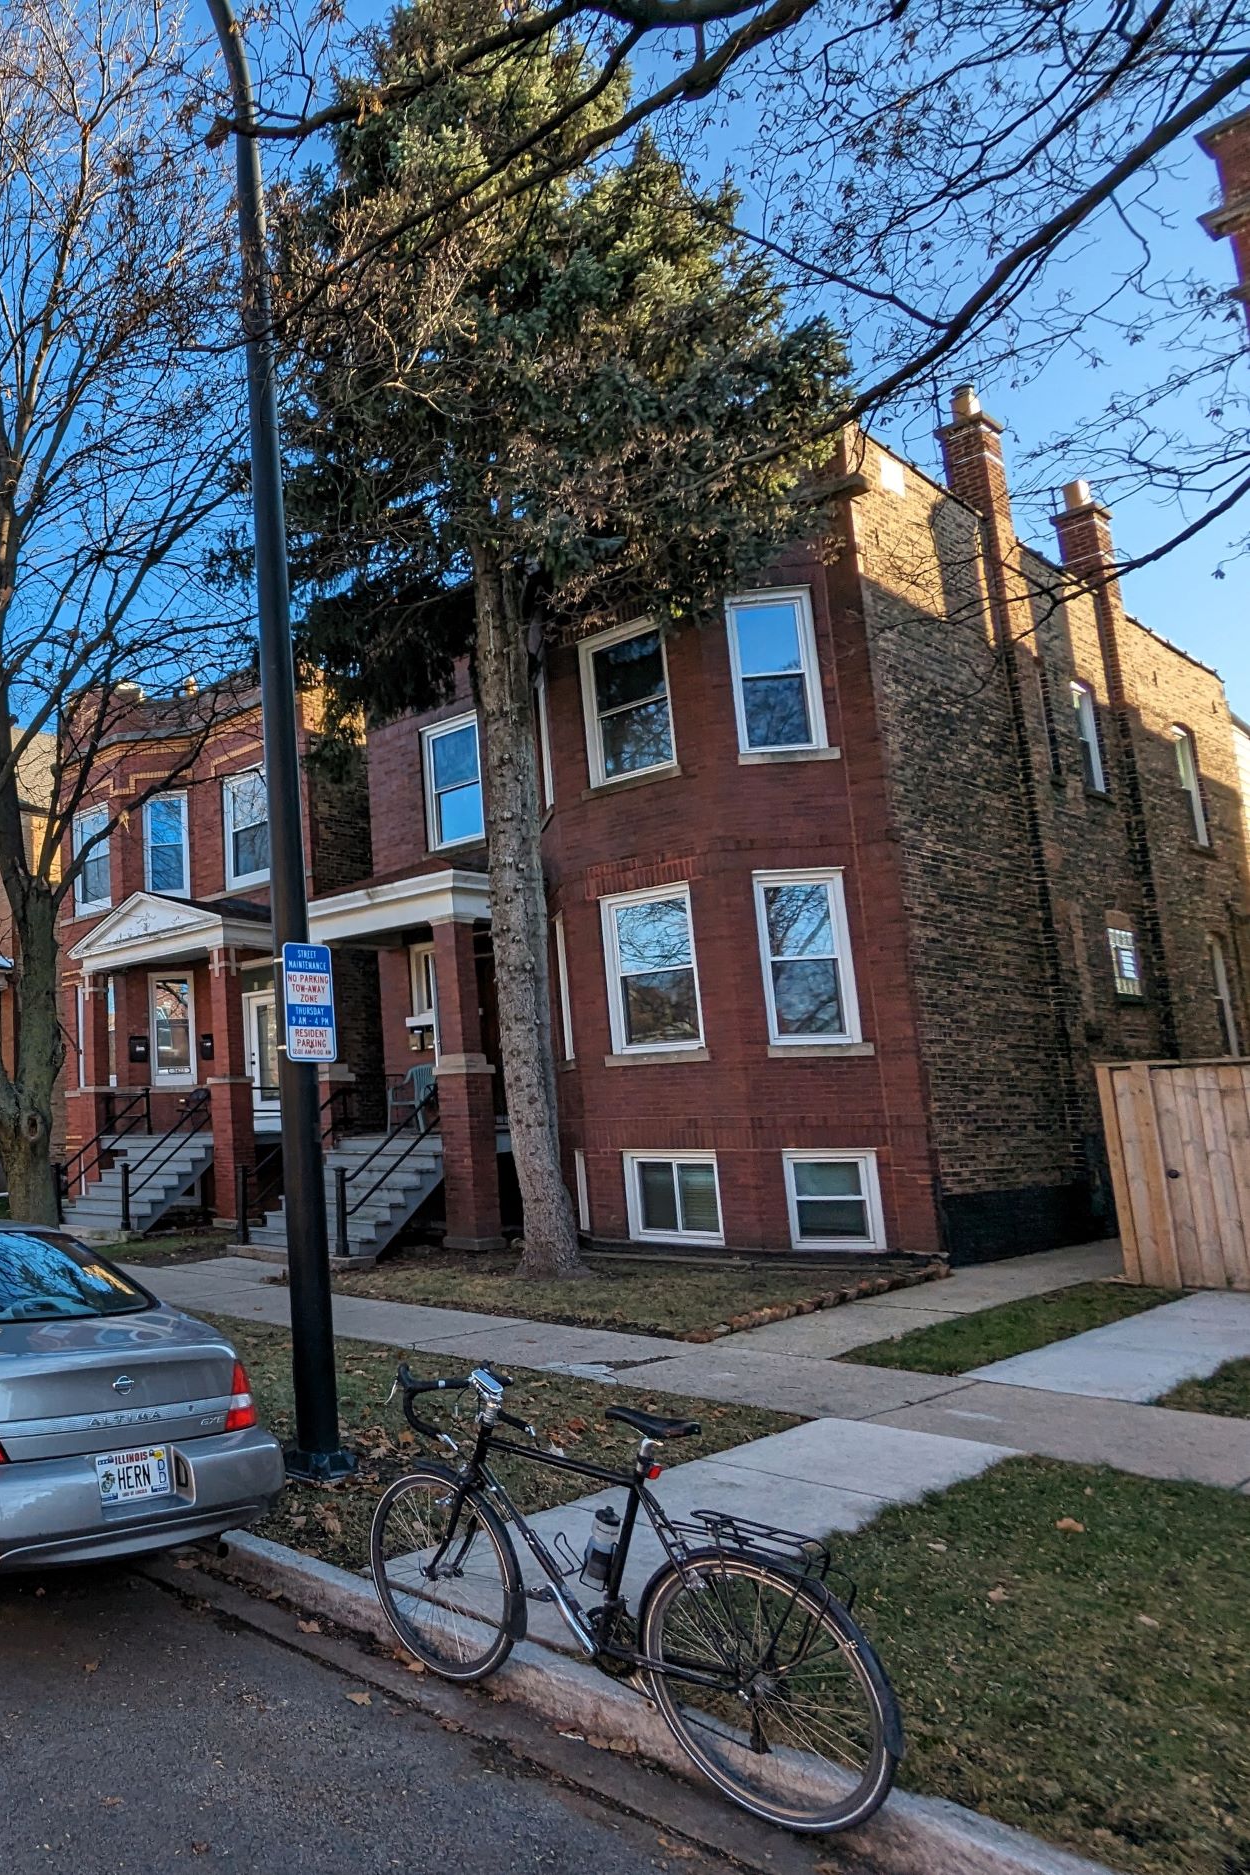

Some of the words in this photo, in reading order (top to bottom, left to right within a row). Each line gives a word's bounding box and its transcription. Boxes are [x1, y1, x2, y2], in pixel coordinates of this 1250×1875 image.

[297, 949, 317, 960] STREET
[288, 960, 327, 971] MAINTENANCE
[287, 974, 298, 983] NO
[299, 974, 329, 984] PARKING
[292, 983, 326, 994] TOW-AWAY
[300, 994, 318, 1003] ZONE
[295, 1006, 325, 1016] THURSDAY
[292, 1016, 296, 1025] 9
[298, 1016, 307, 1025] AM
[314, 1017, 319, 1025] 4
[321, 1017, 330, 1026] PM
[294, 1028, 328, 1038] RESIDENT
[296, 1038, 327, 1048] PARKING
[88, 1411, 162, 1428] ALTIMA
[200, 1415, 226, 1426] GXE
[114, 1451, 148, 1465] ILLINOIS
[117, 1463, 151, 1490] HERN
